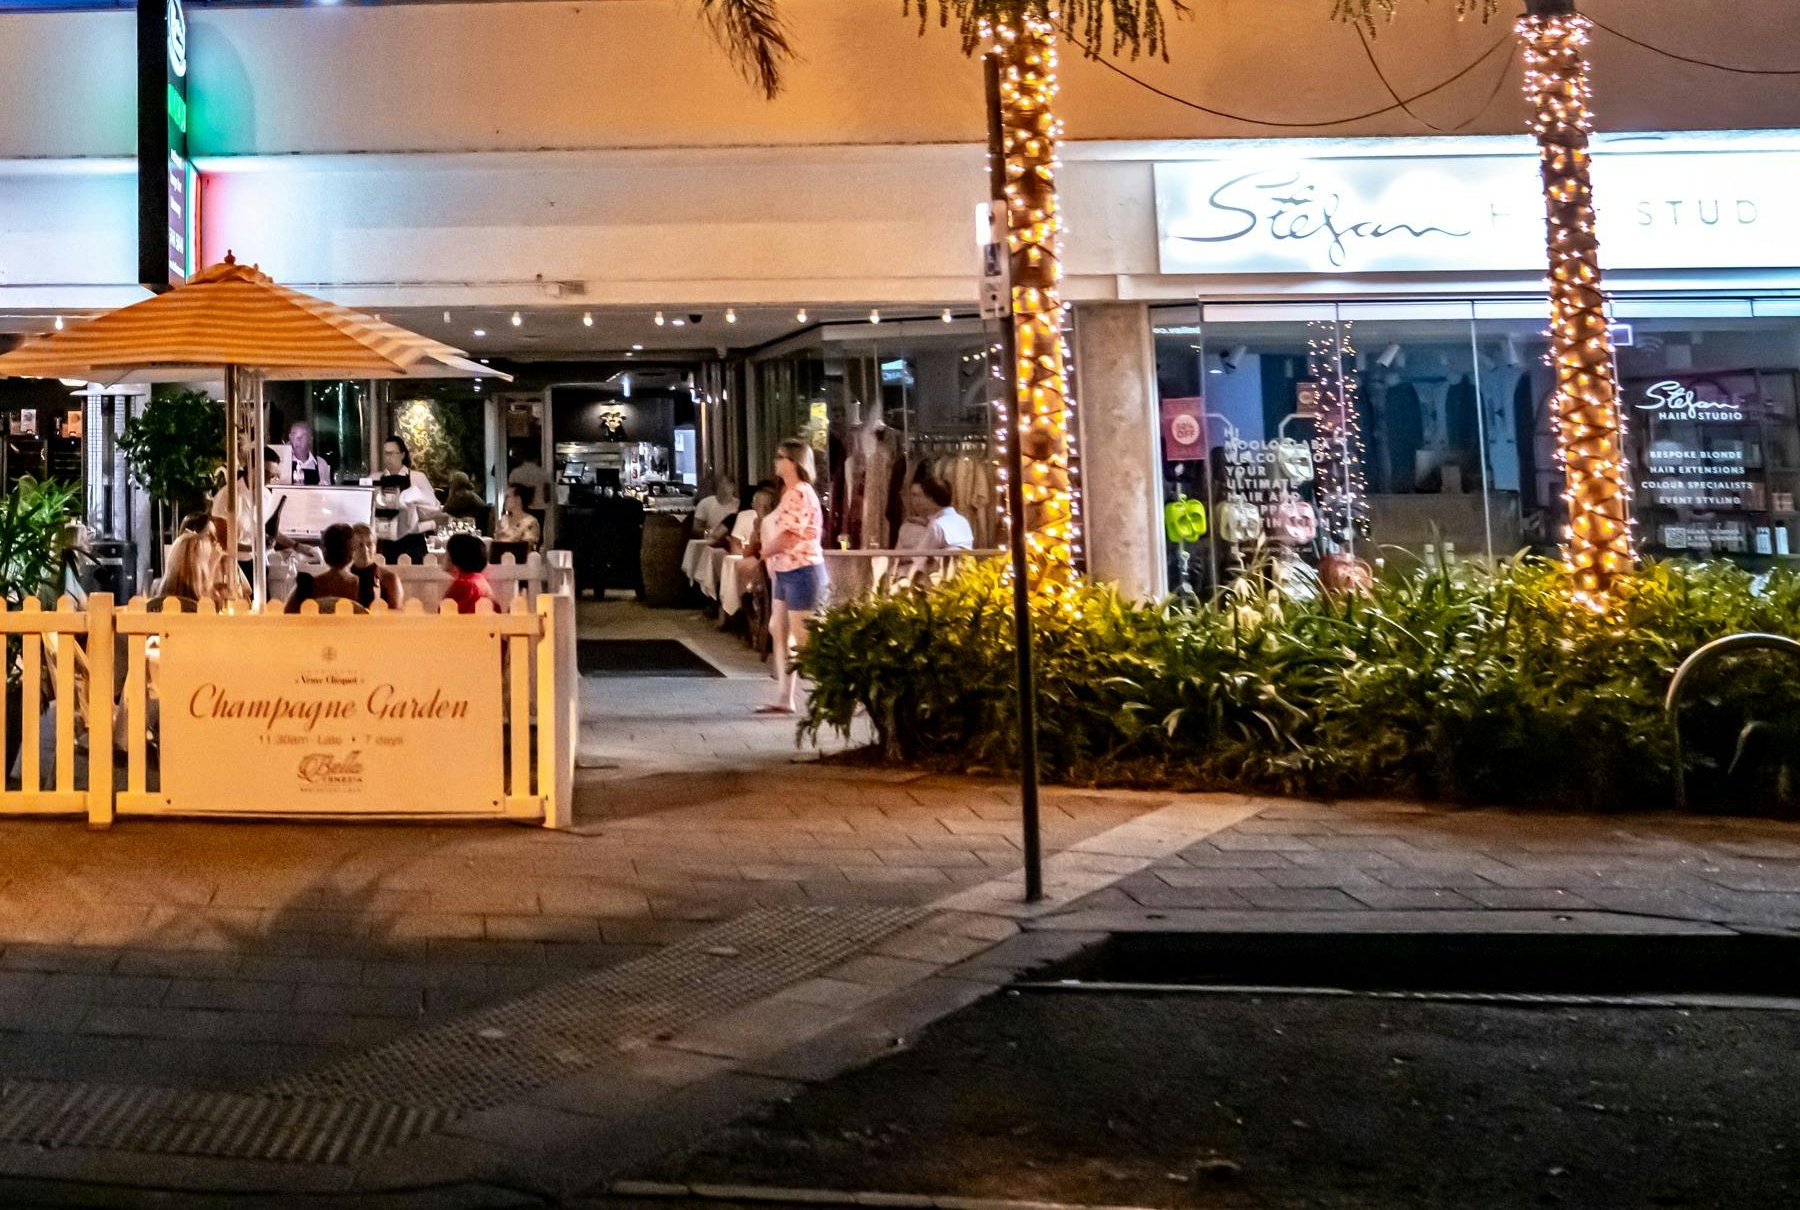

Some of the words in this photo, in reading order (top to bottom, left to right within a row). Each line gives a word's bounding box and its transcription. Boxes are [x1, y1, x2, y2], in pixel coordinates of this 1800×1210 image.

[1170, 170, 1471, 266] Stefan
[1635, 380, 1740, 419] Stefan
[1659, 412, 1688, 420] HAIR
[1698, 412, 1743, 420] STUDIO
[1650, 451, 1696, 459] BESPOKE
[1700, 451, 1742, 459] BLONDE
[1225, 466, 1266, 476] YOUR
[1650, 466, 1675, 474] HAIR
[1679, 466, 1745, 474] EXTENSIONS
[1227, 478, 1299, 489] ULTIMATE
[1641, 481, 1684, 489] COLOUR
[1687, 481, 1753, 489] SPECIALISTS
[1659, 496, 1693, 504] EVENT
[1696, 496, 1741, 504] STYLING
[189, 683, 357, 731] Champagne
[366, 683, 469, 720] Garden
[297, 750, 363, 783] Bella
